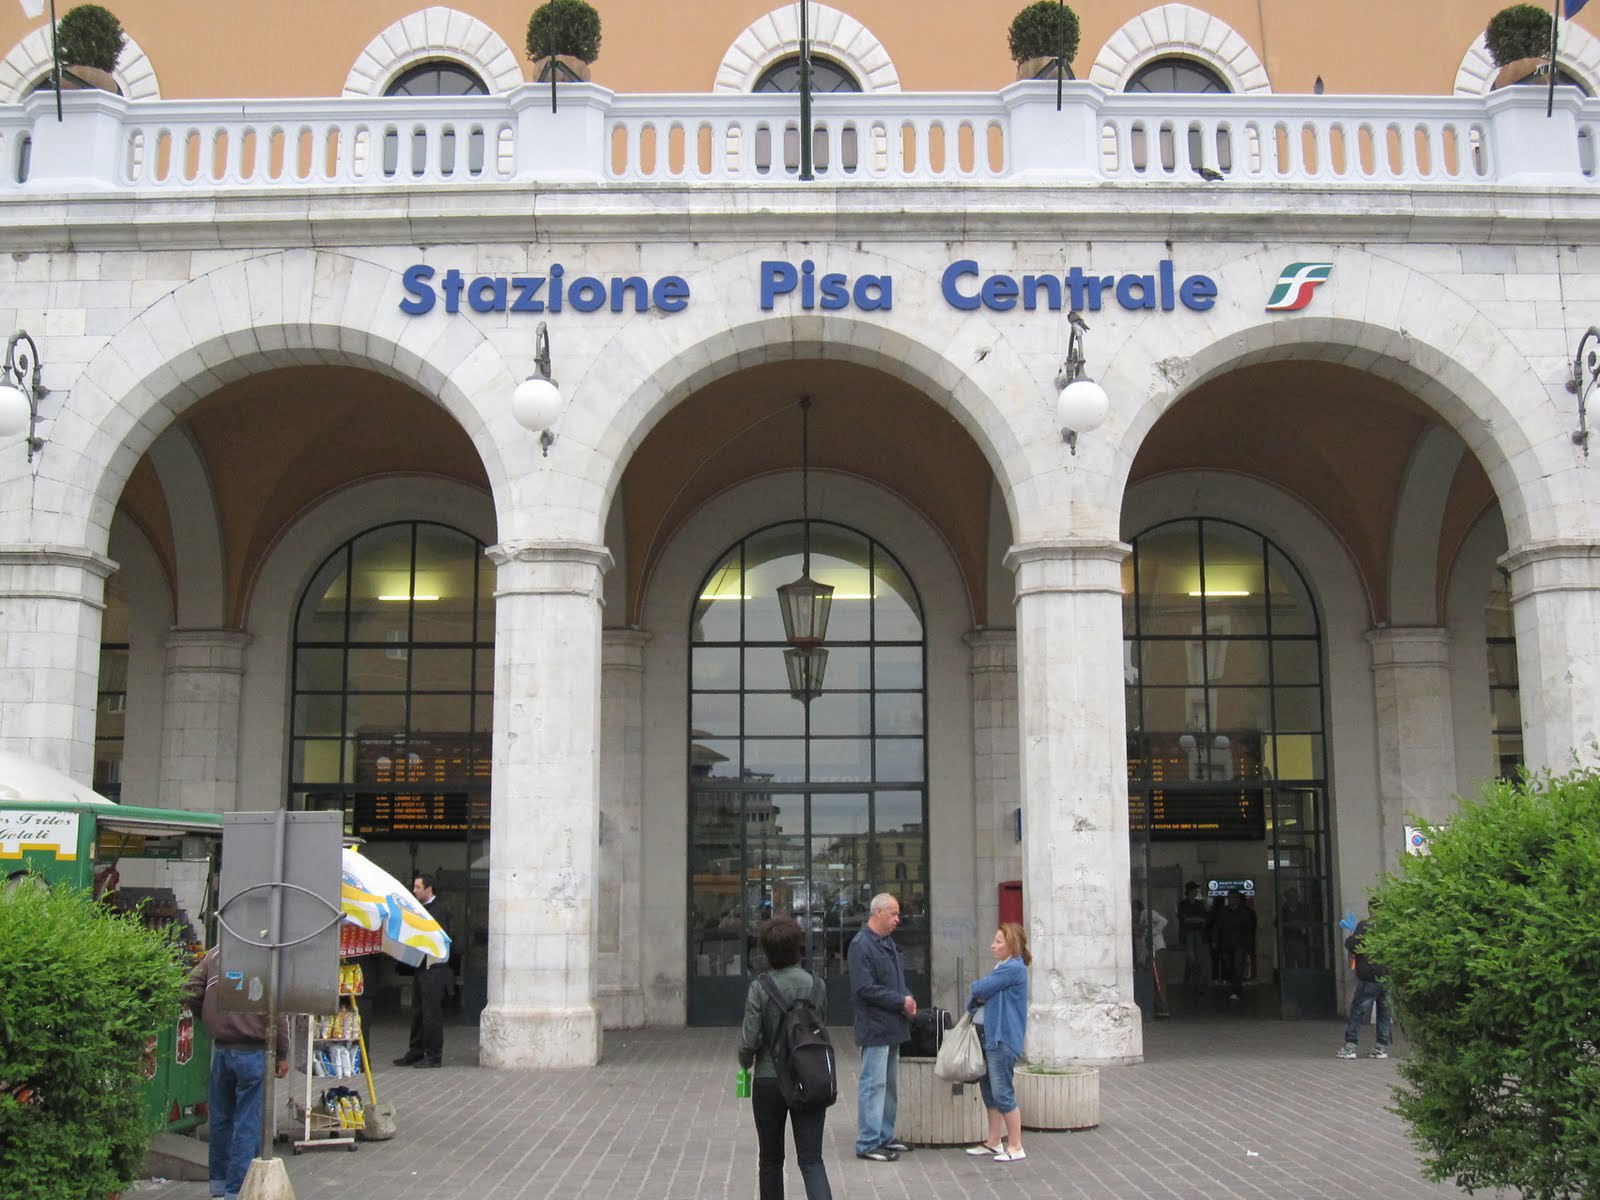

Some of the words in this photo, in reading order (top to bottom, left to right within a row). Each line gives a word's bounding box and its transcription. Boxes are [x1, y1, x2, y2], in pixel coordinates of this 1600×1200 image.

[400, 264, 689, 315] Stazione
[761, 260, 892, 310] Pisa
[943, 260, 1217, 310] Centrale
